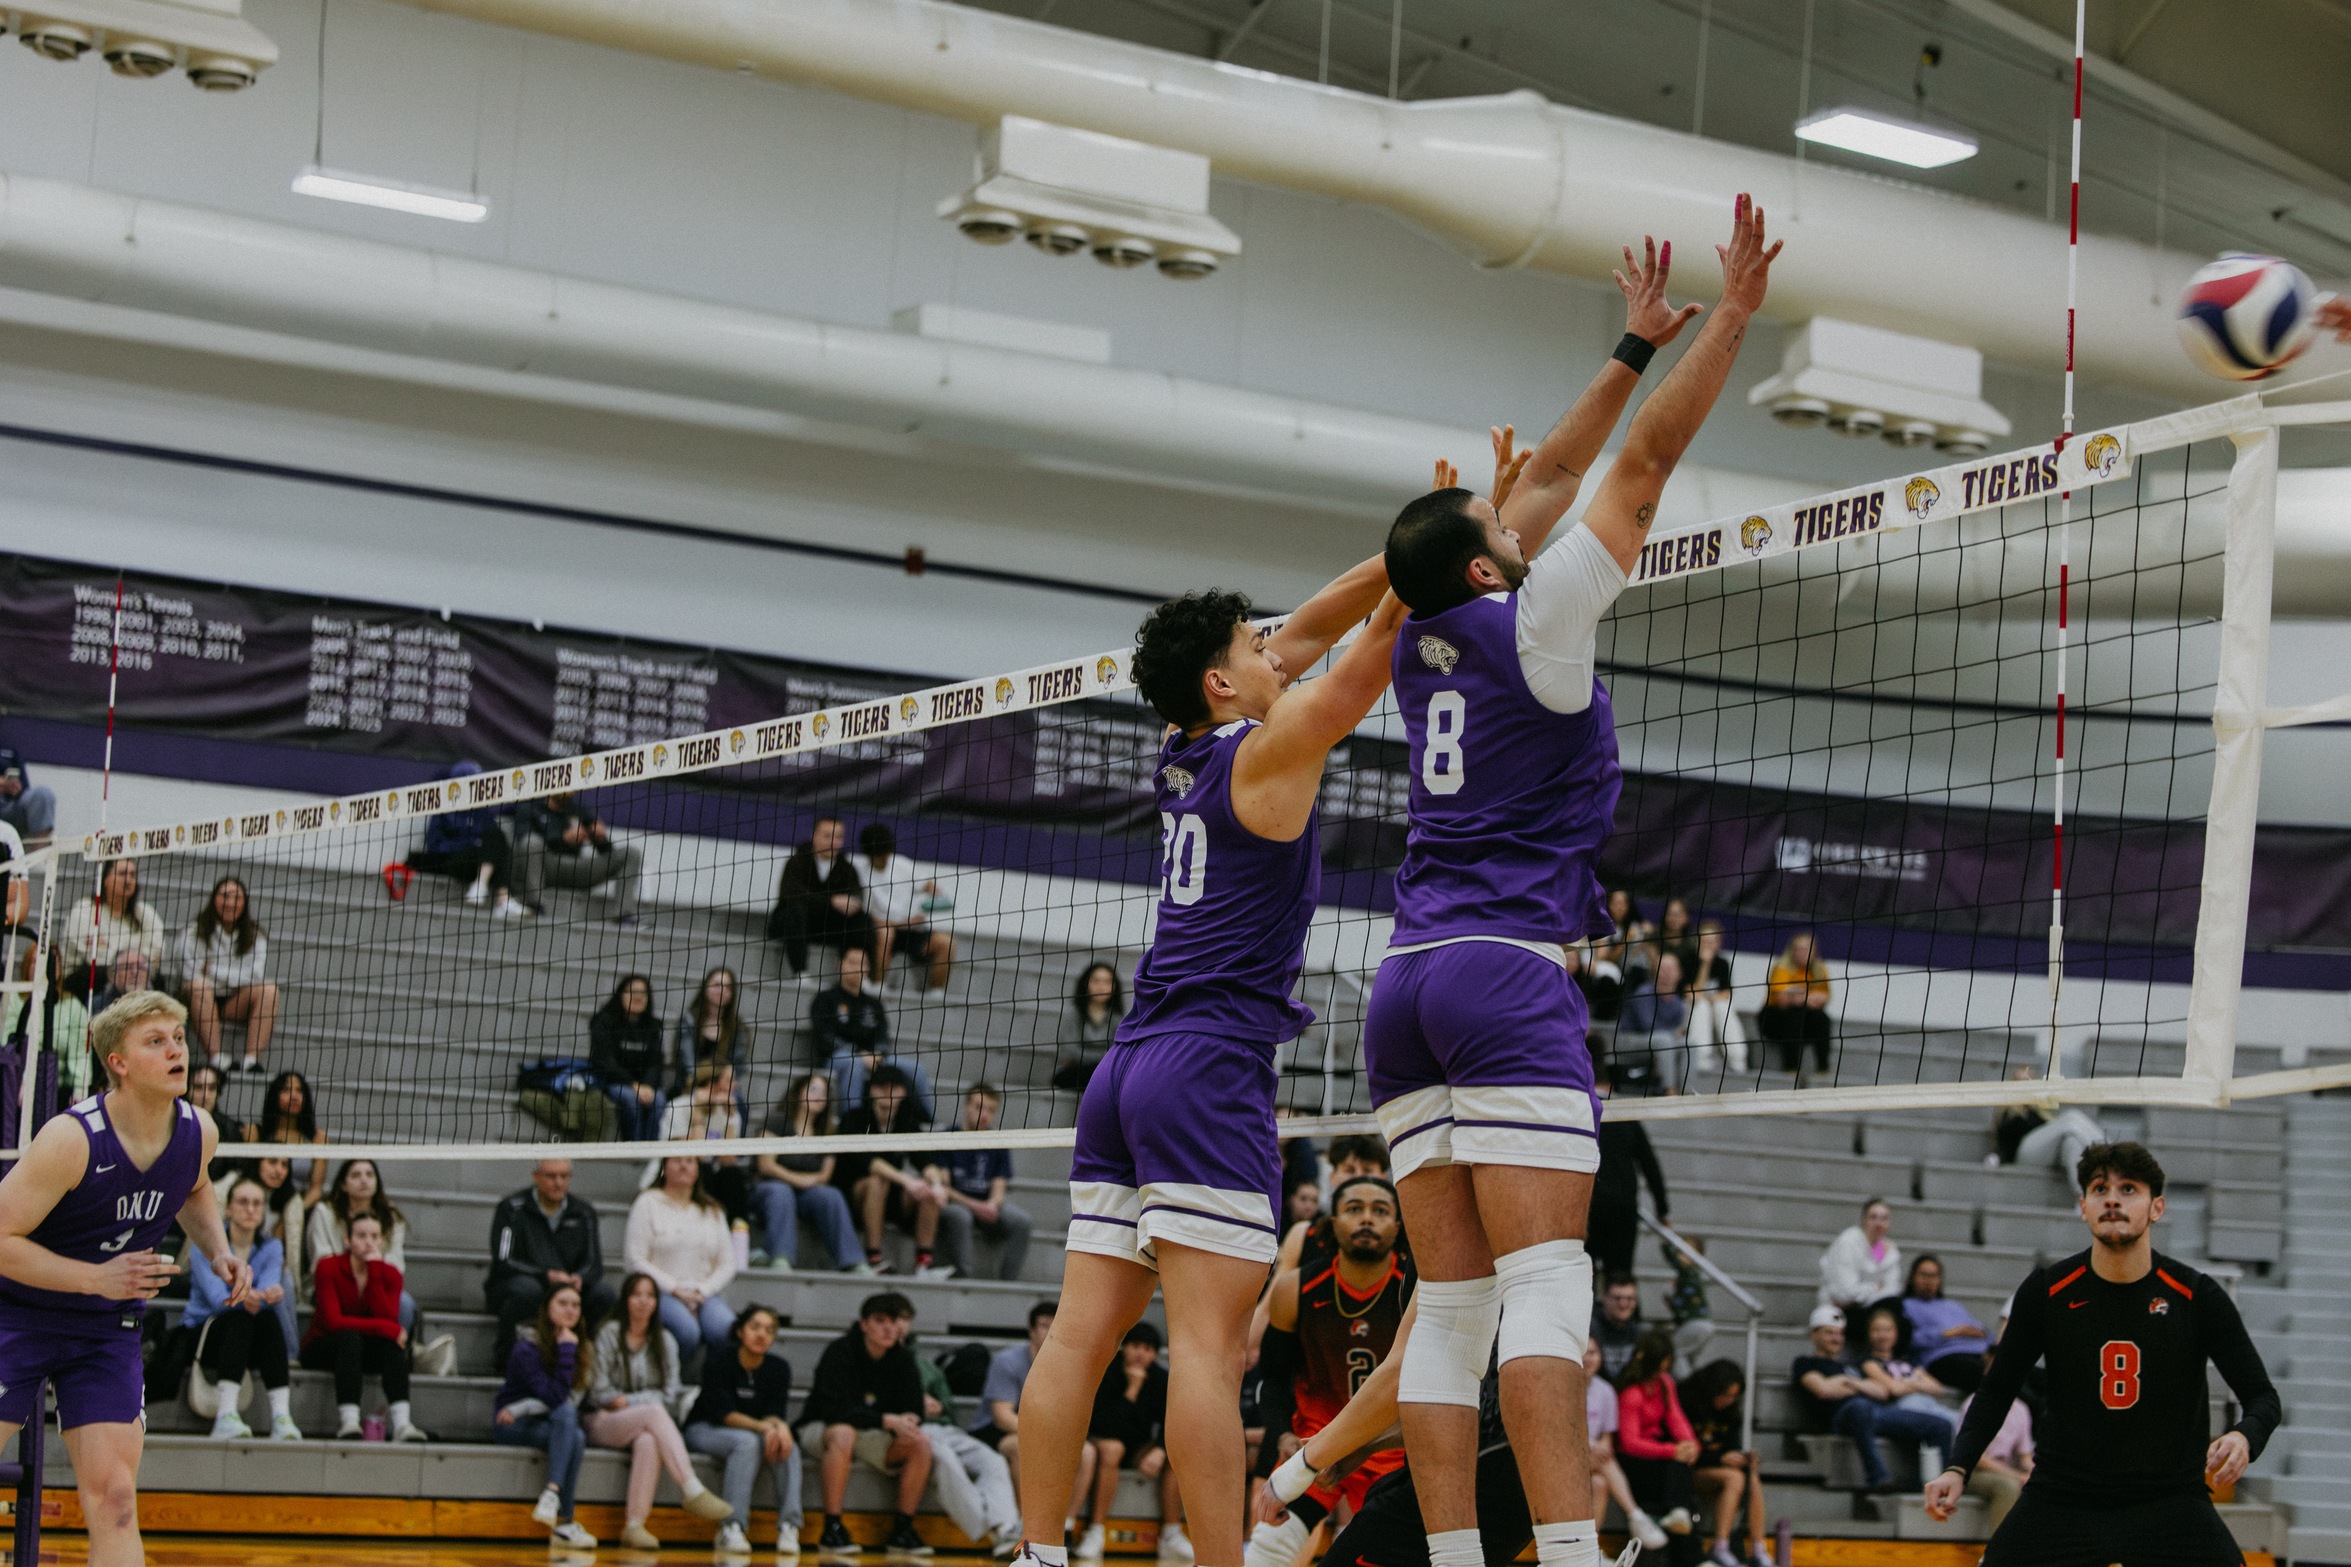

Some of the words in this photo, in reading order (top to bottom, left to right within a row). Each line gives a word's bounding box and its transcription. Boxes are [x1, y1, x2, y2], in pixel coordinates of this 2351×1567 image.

[349, 797, 380, 823] TIGERS
[407, 787, 441, 813] TIGERS
[469, 776, 504, 803] TIGERS
[534, 763, 572, 792] TIGERS
[604, 751, 644, 780] TIGERS
[677, 737, 720, 769] TIGERS
[756, 721, 802, 754] TIGERS
[841, 704, 890, 738] TIGERS
[931, 686, 984, 722] TIGERS
[1028, 666, 1083, 705] TIGERS
[1637, 529, 1722, 581] TIGERS
[1792, 490, 1885, 548] TIGERS
[1962, 453, 2059, 510] TIGERS
[1423, 690, 1466, 795] 8
[2100, 1340, 2141, 1410] 8
